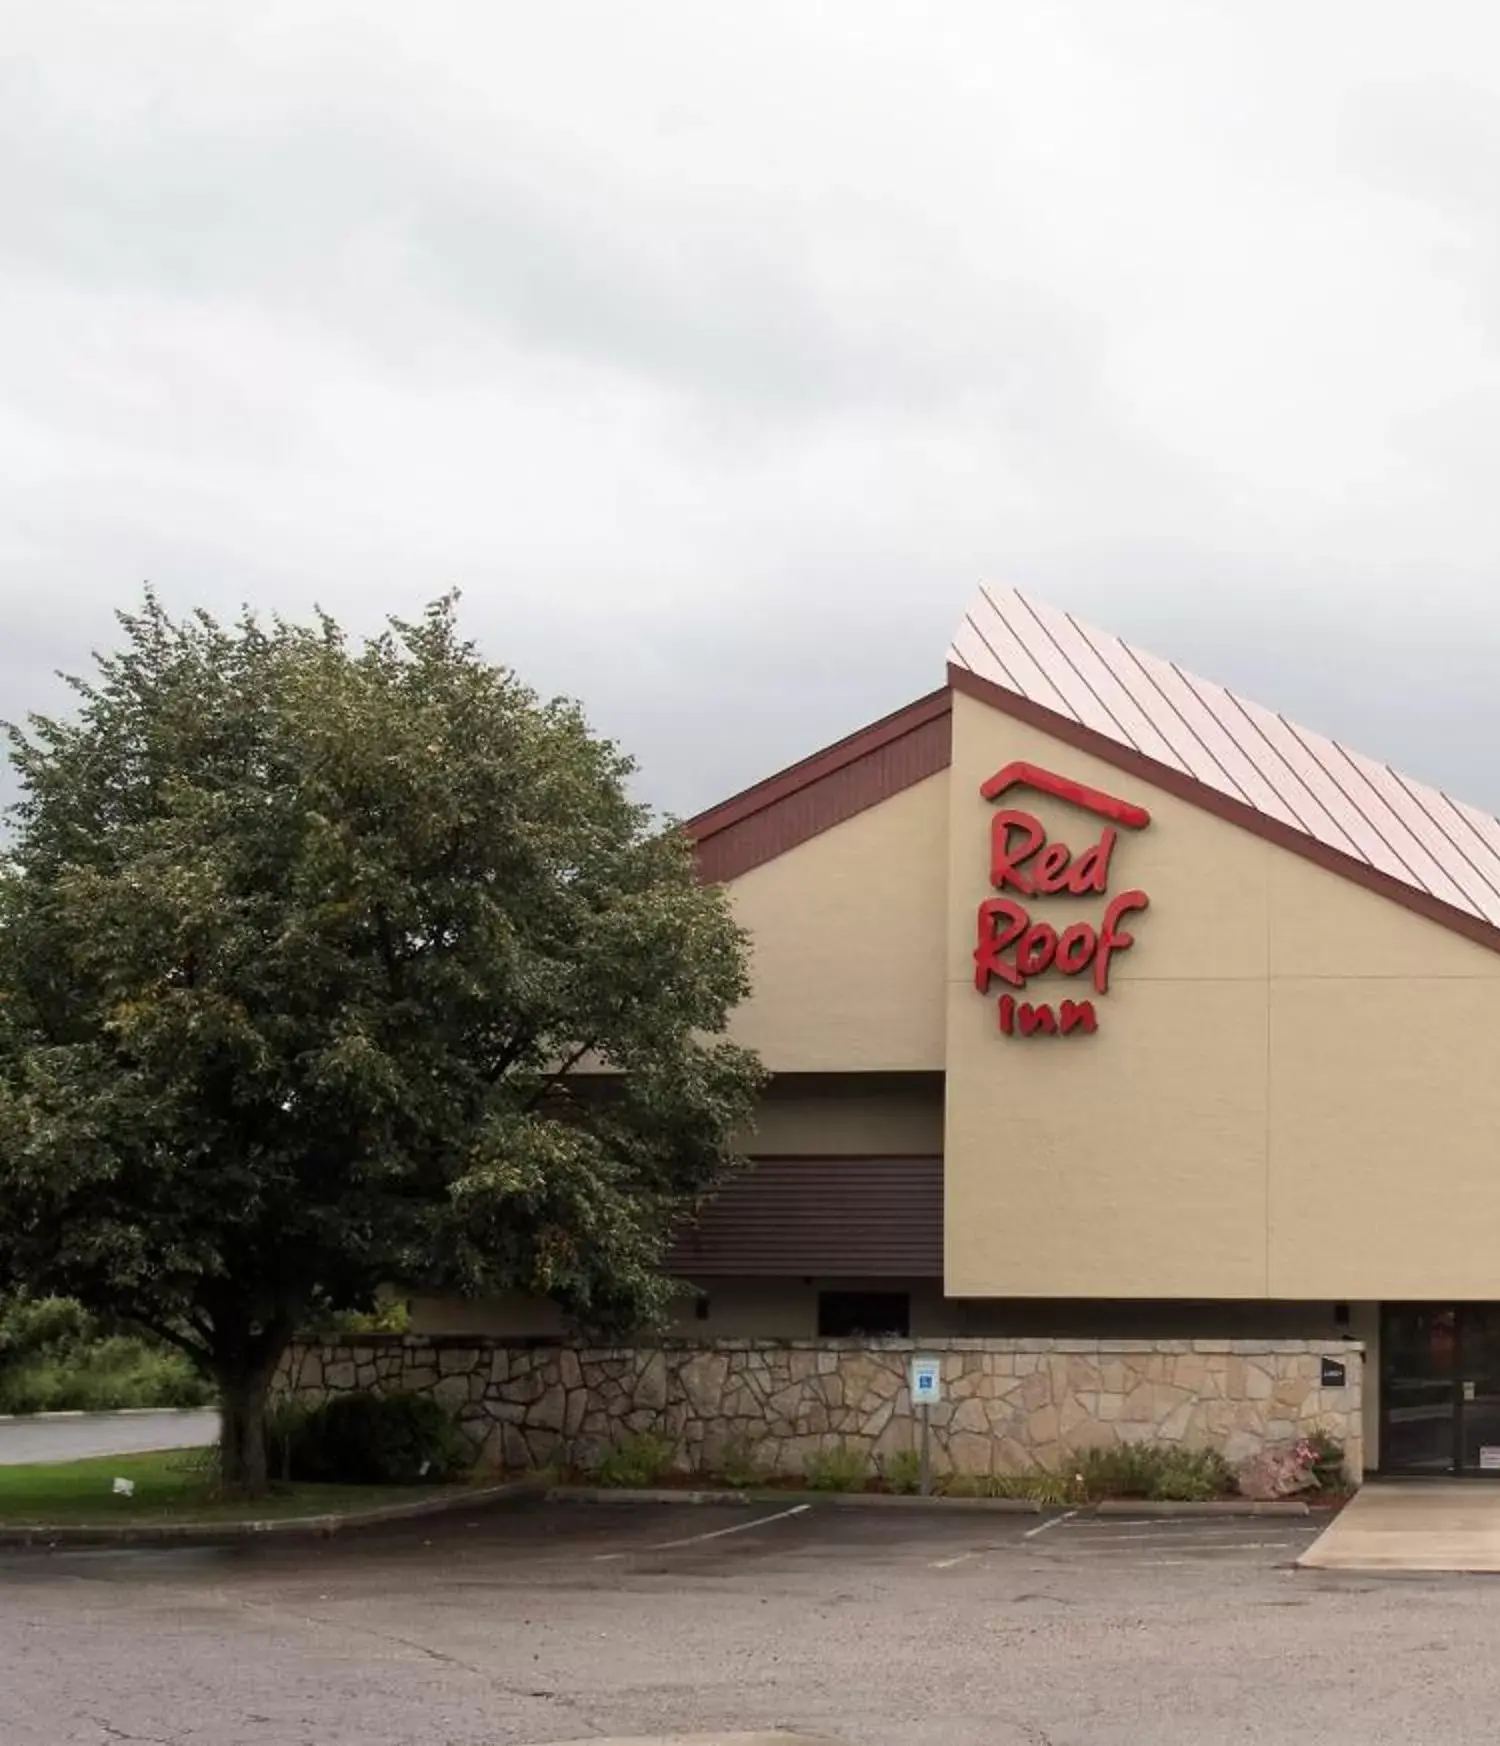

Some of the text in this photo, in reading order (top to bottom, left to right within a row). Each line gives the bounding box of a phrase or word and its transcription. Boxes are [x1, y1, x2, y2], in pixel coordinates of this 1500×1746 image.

[990, 808, 1117, 896] Red
[973, 889, 1150, 995] Roof
[997, 993, 1099, 1038] Inn
